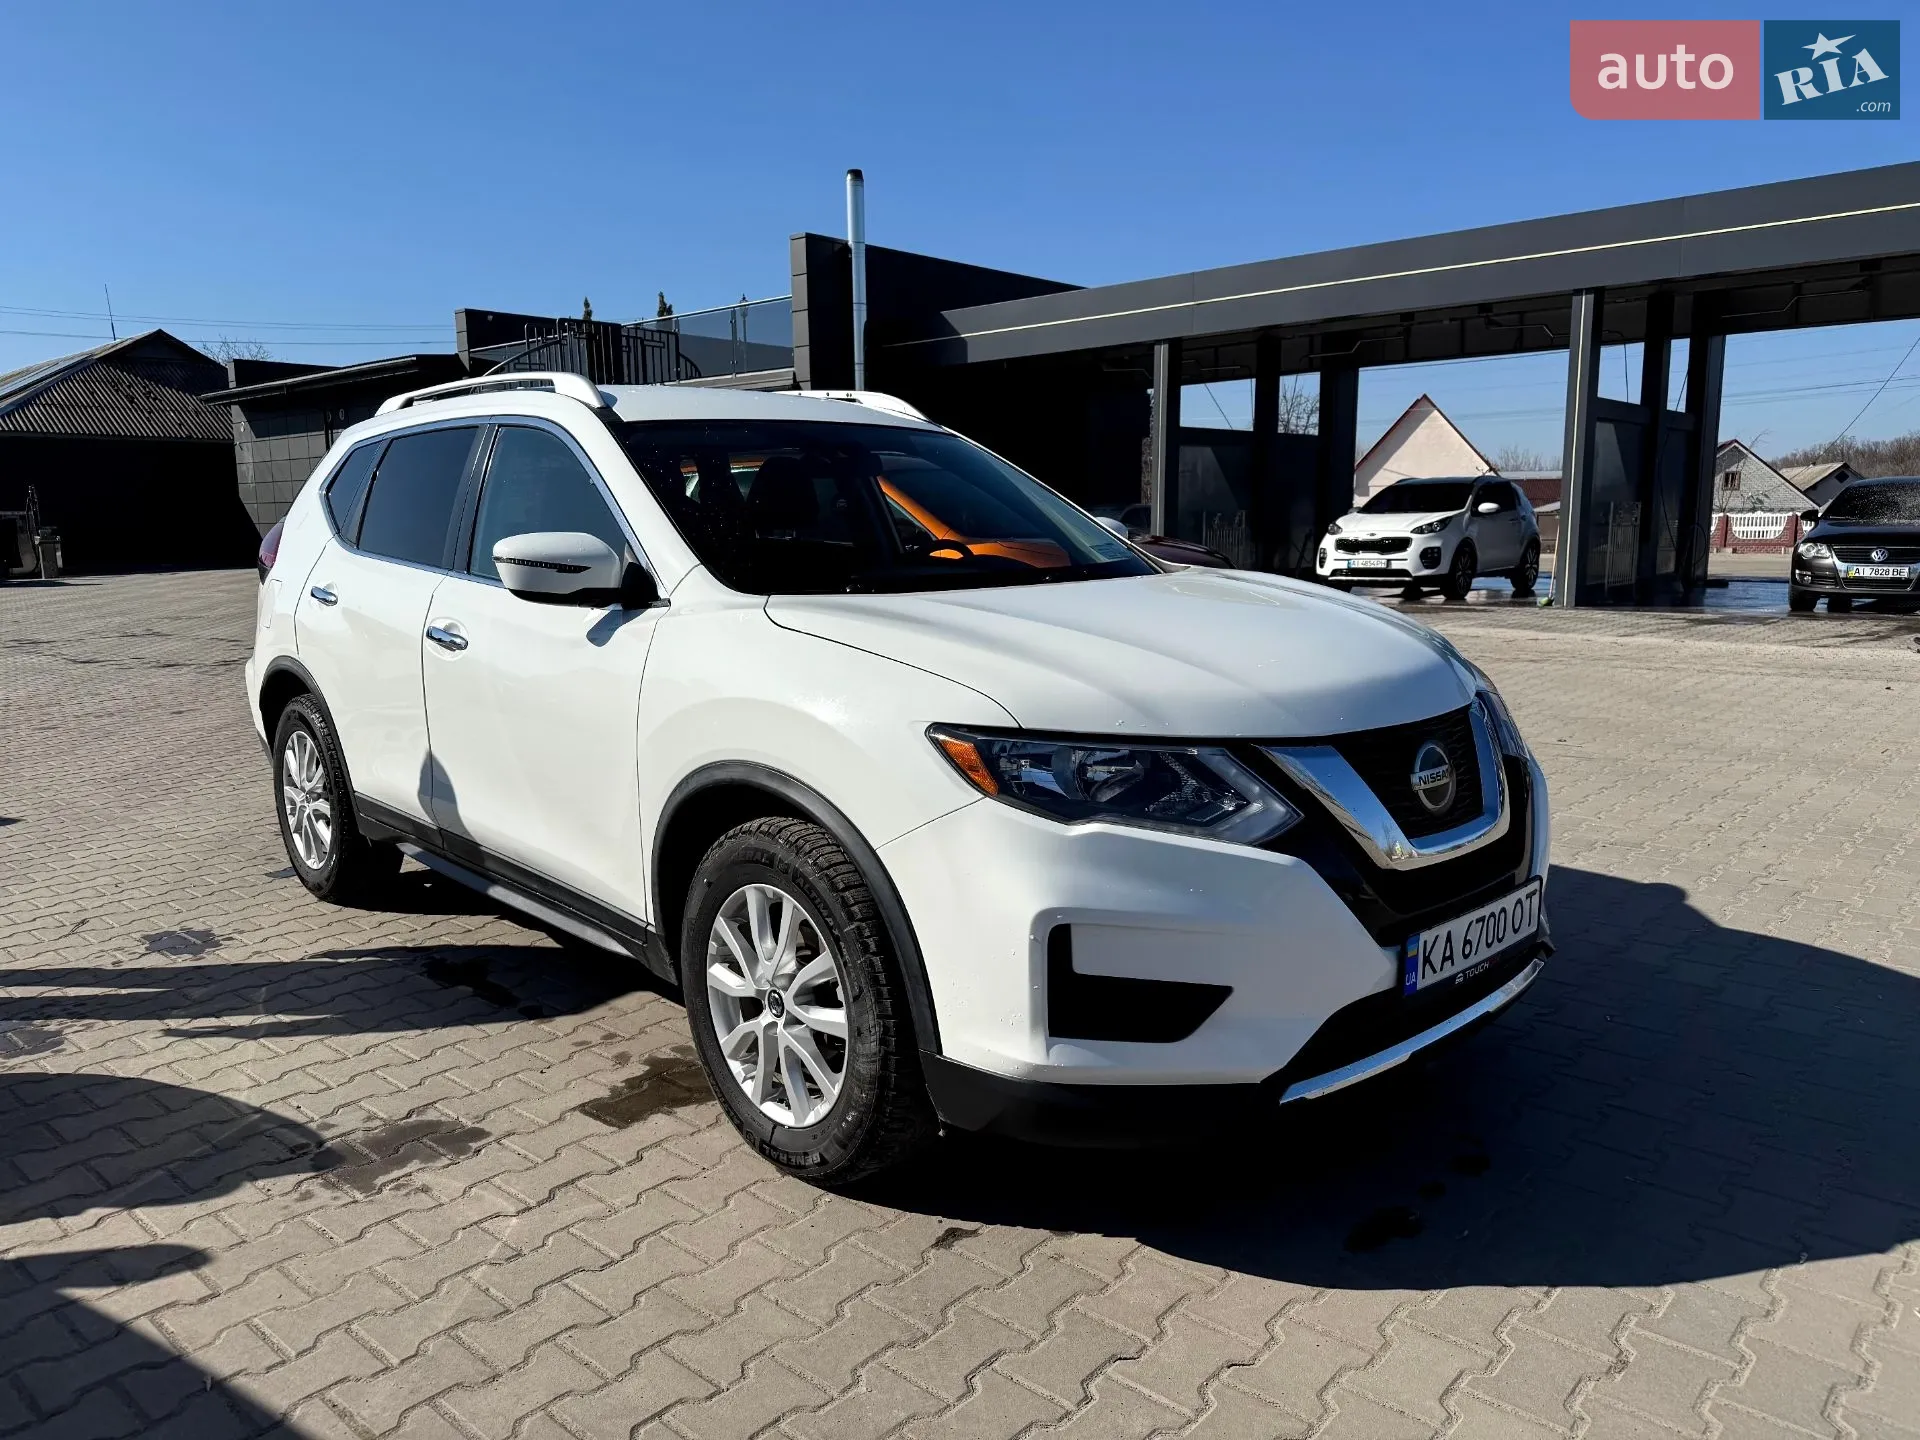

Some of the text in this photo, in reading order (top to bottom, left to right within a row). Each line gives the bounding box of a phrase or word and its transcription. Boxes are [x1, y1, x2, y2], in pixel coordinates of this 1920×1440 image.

[1853, 567, 1906, 578] AI 7828 BE
[1421, 888, 1538, 980] KA 6700 OT
[1465, 960, 1490, 979] TOUCH
[1405, 972, 1416, 985] UA
